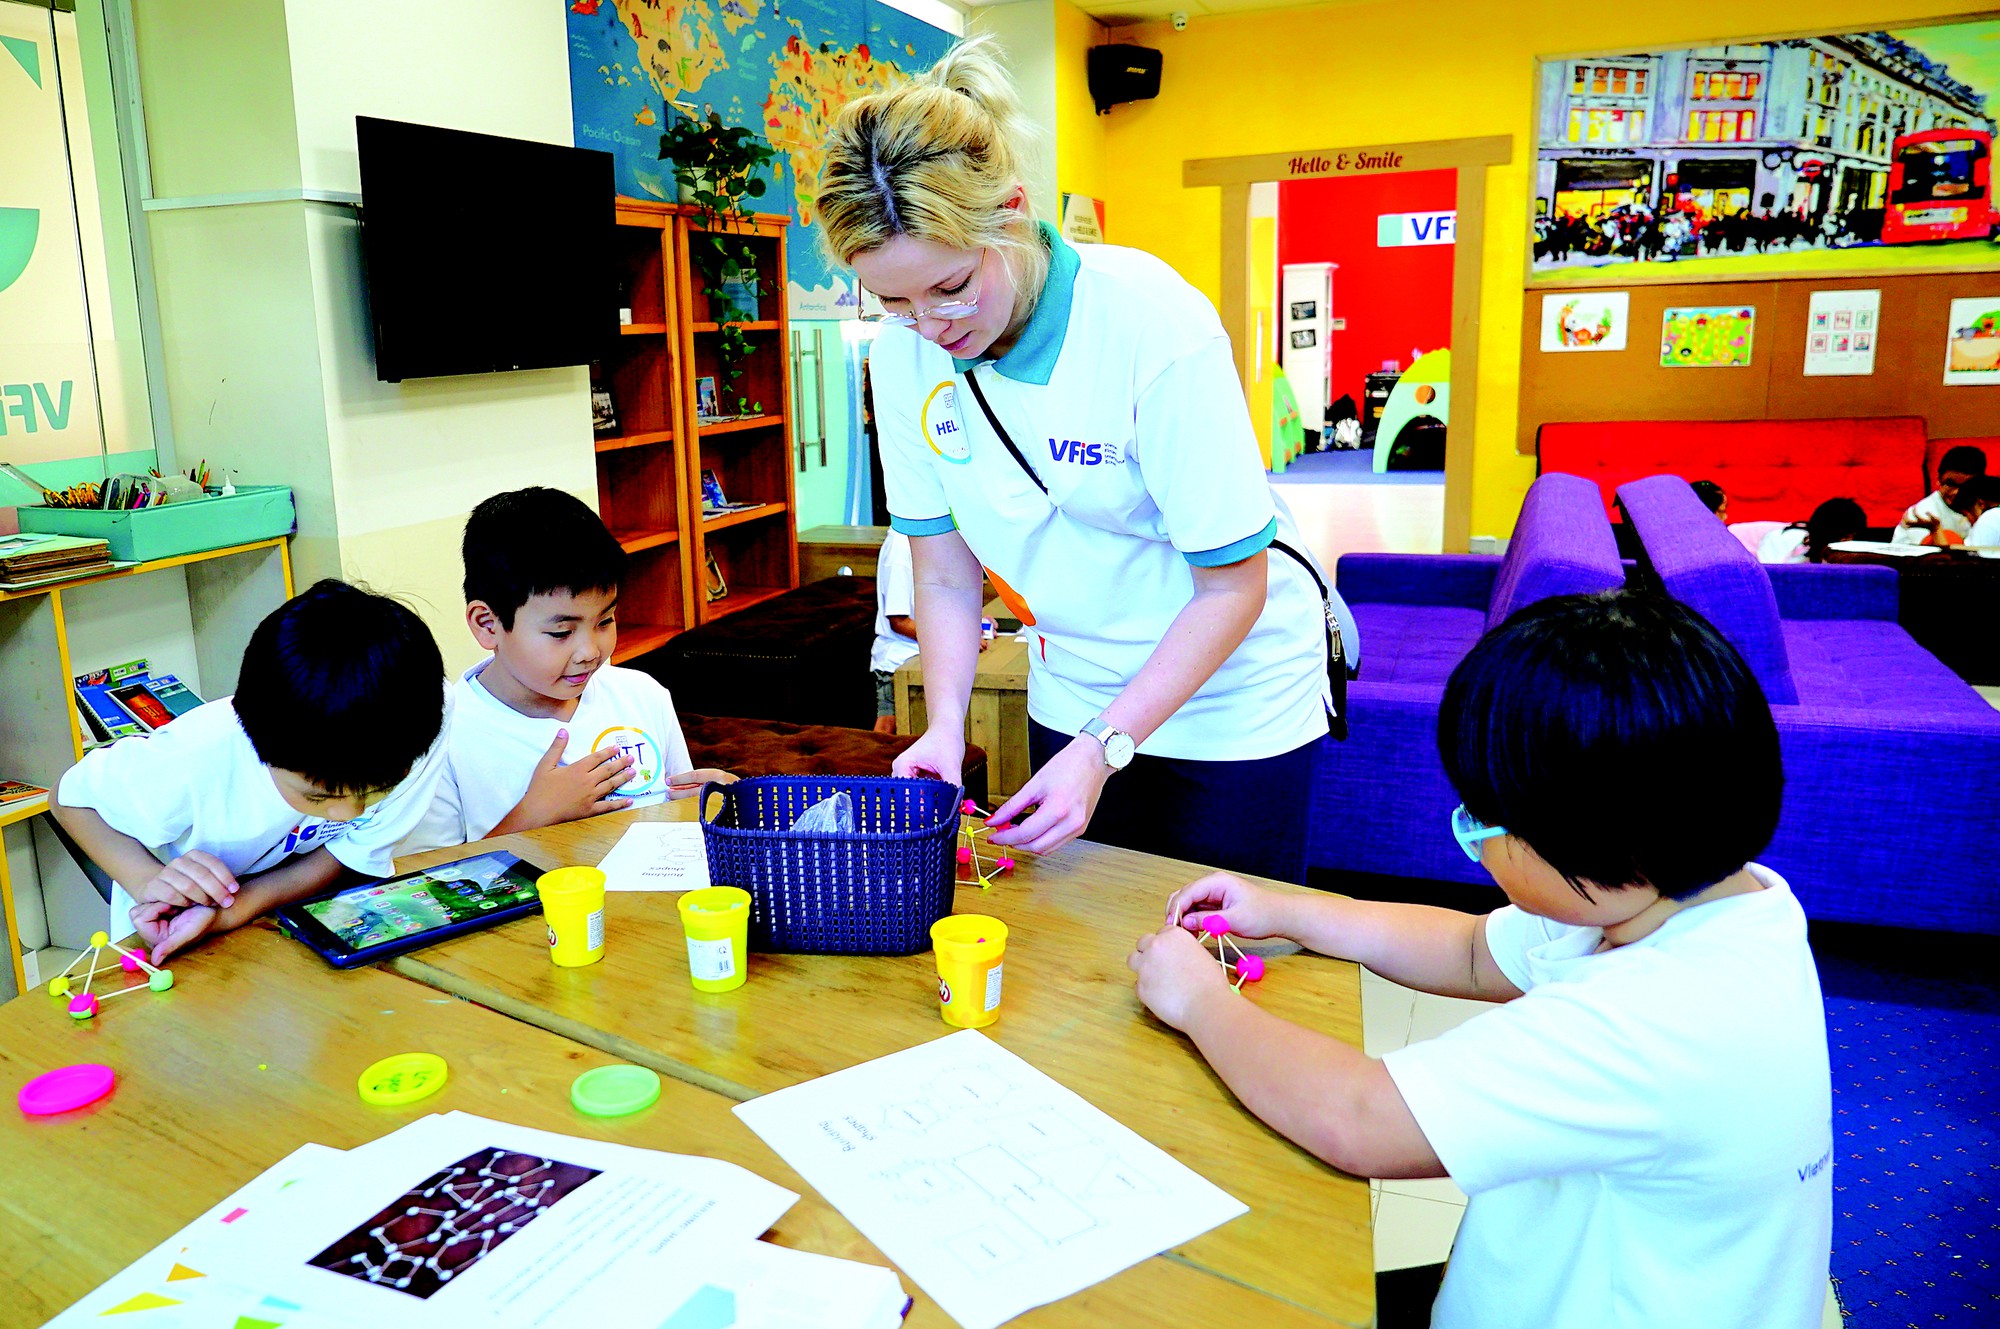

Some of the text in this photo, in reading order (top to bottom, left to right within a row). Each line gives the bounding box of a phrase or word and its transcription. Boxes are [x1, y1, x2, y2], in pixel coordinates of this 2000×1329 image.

[1288, 151, 1403, 175] Hello & Smile
[936, 420, 960, 436] HEL
